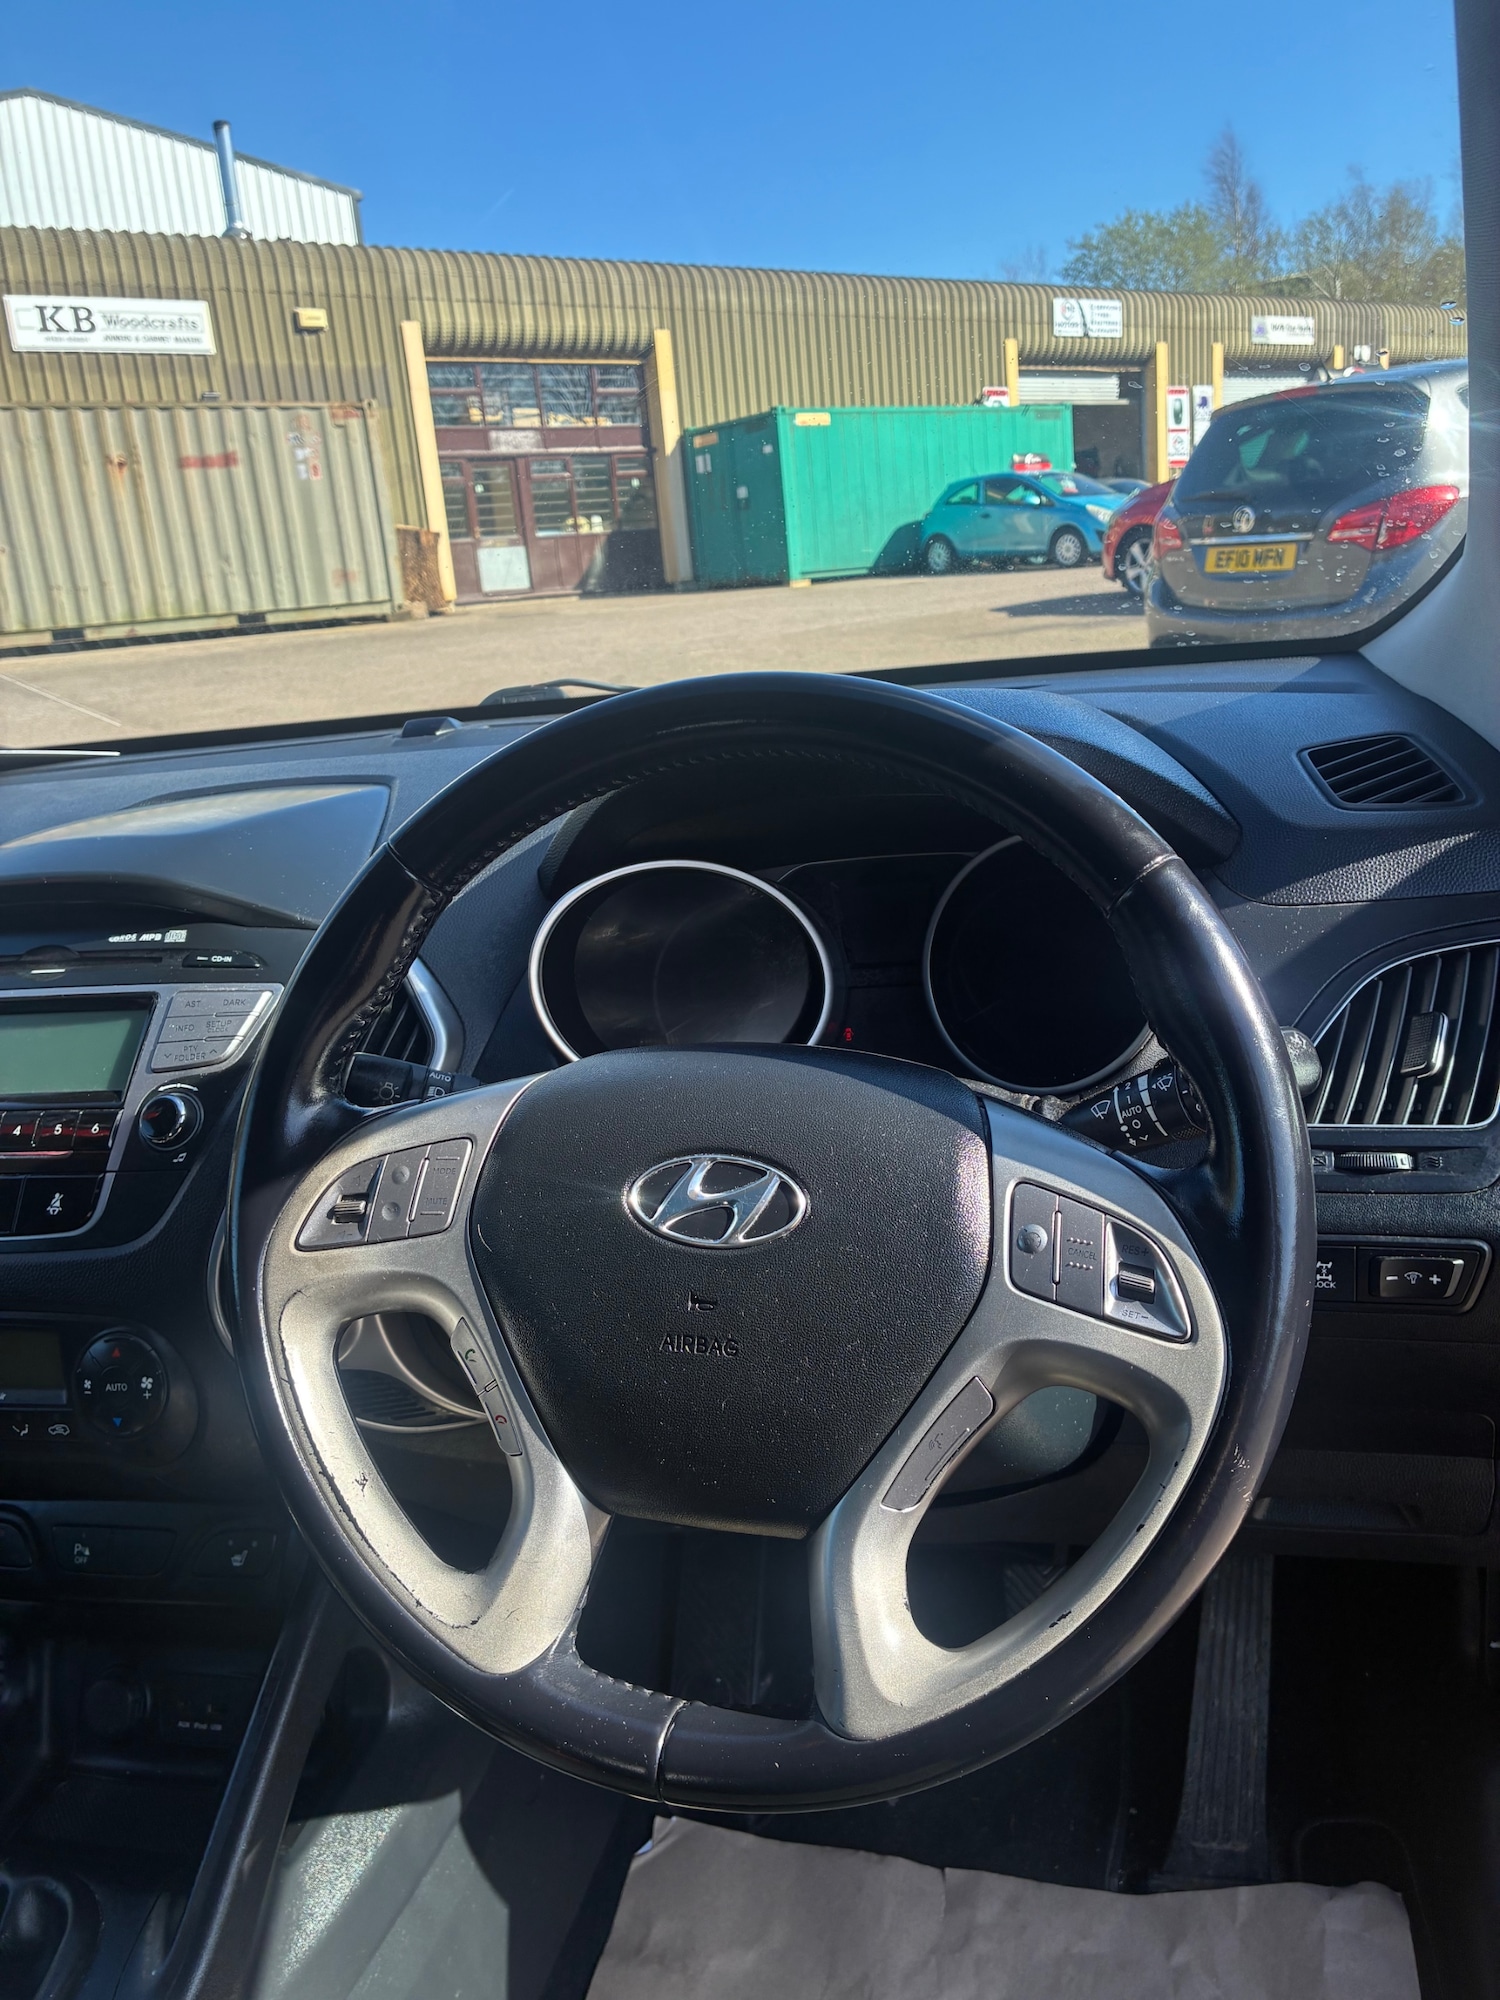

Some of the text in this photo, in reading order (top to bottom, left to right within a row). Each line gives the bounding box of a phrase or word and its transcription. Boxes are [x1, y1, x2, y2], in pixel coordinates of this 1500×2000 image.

[34, 304, 200, 333] KB Woodcrafts
[211, 955, 233, 963] CD-IN
[185, 1000, 201, 1008] AST
[223, 998, 246, 1006] DARK
[175, 1024, 195, 1032] INFO
[206, 1020, 232, 1028] SETUP
[174, 1052, 207, 1062] FOLDER
[429, 1072, 452, 1082] AUTO
[1125, 1082, 1131, 1090] 2
[1121, 1105, 1142, 1119] AUTO
[12, 1125, 21, 1136] 4
[54, 1124, 62, 1135] 5
[91, 1122, 99, 1134] 6
[433, 1167, 456, 1175] MODE
[426, 1197, 447, 1206] MUTE
[1068, 1247, 1097, 1261] CANCEL
[659, 1333, 740, 1358] AIRBAG
[105, 1383, 128, 1392] AUTO
